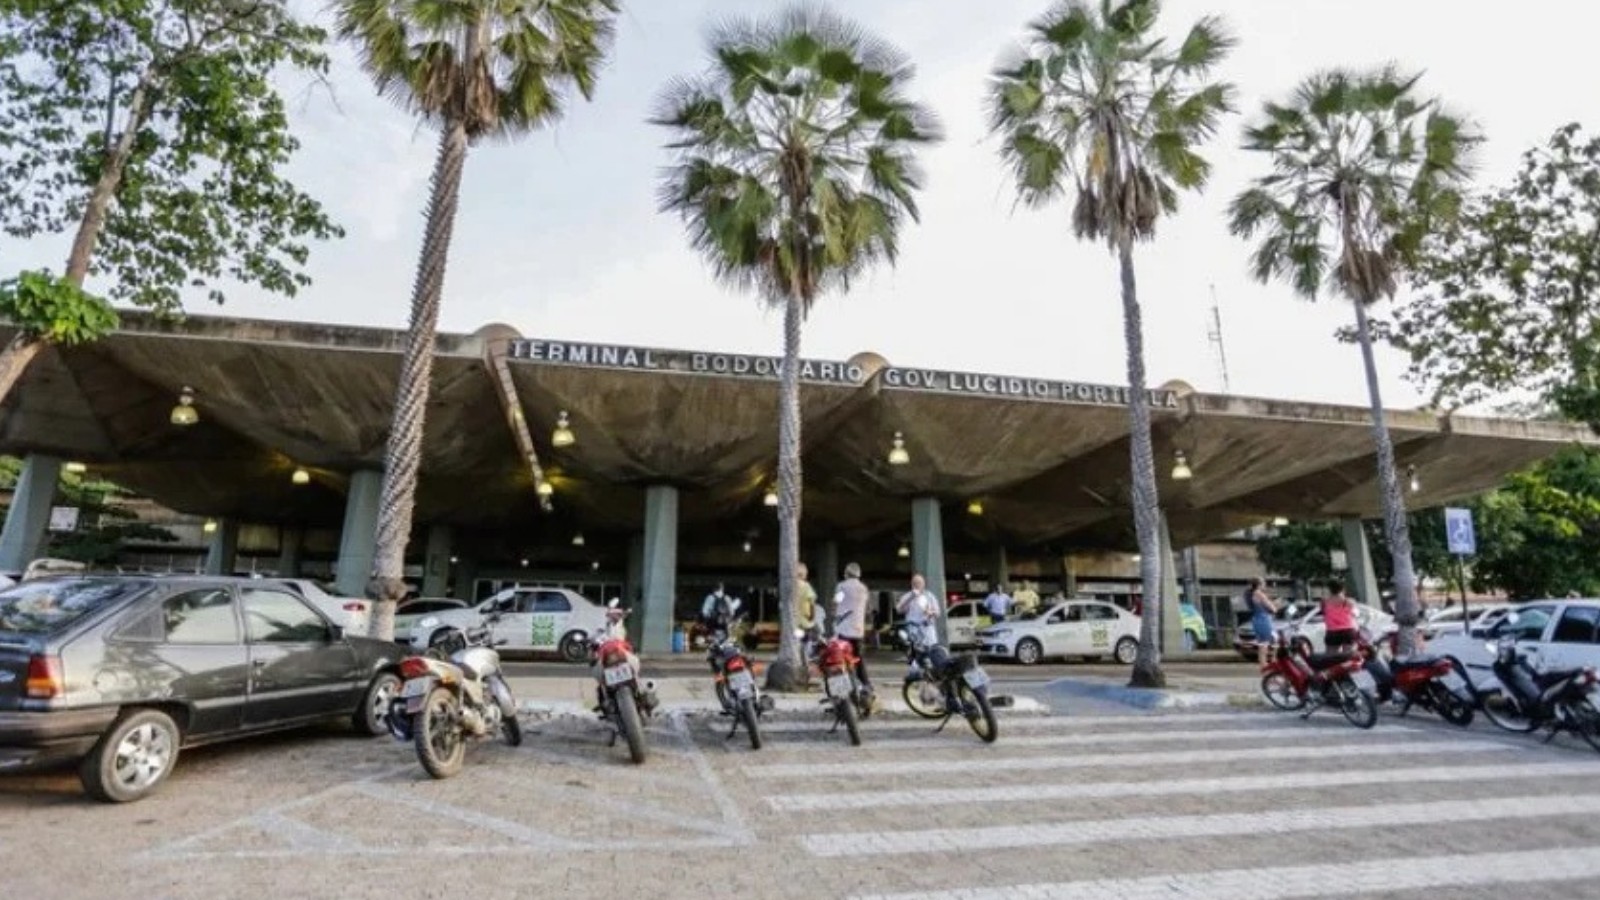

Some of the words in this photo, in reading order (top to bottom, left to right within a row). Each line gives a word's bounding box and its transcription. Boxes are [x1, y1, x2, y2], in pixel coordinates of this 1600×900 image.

[512, 340, 658, 368] TERMINAL
[884, 368, 936, 388] GOV
[949, 372, 1048, 395] LUCIDIO
